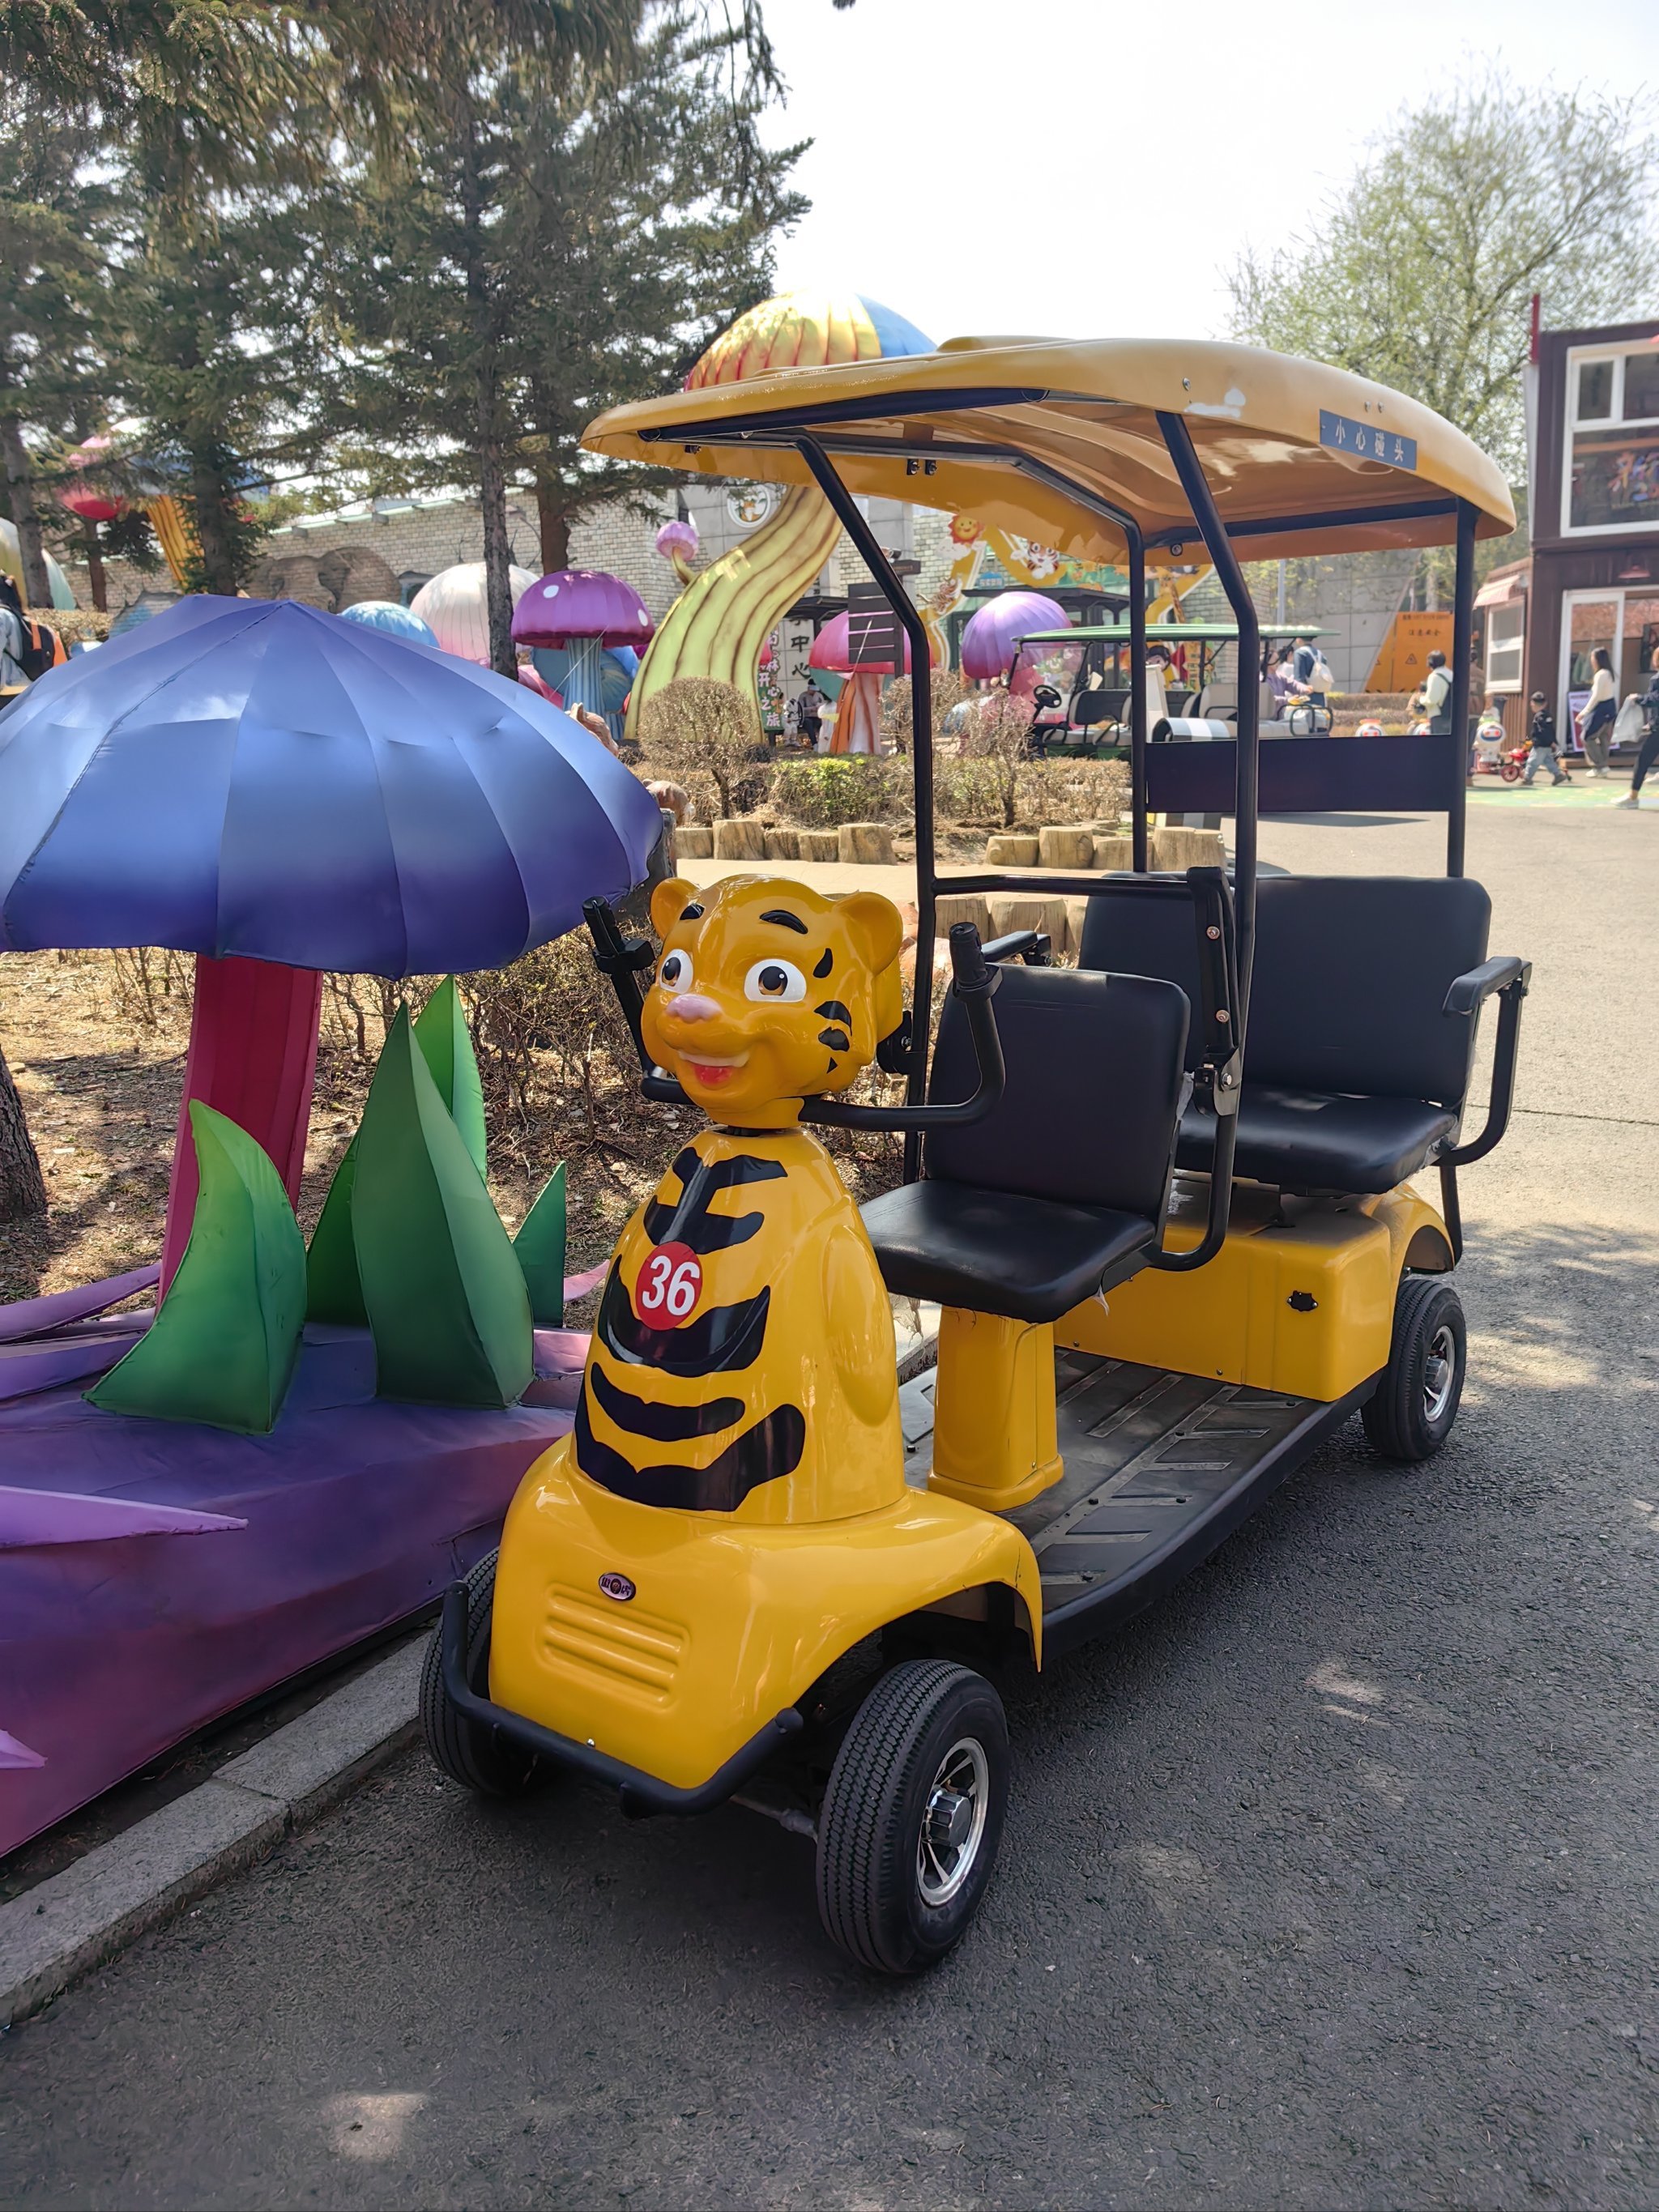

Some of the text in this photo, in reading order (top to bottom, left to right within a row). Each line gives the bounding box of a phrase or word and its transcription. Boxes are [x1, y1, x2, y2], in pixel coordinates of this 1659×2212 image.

[1335, 418, 1405, 462] 小心碰头
[642, 1255, 701, 1316] 36
